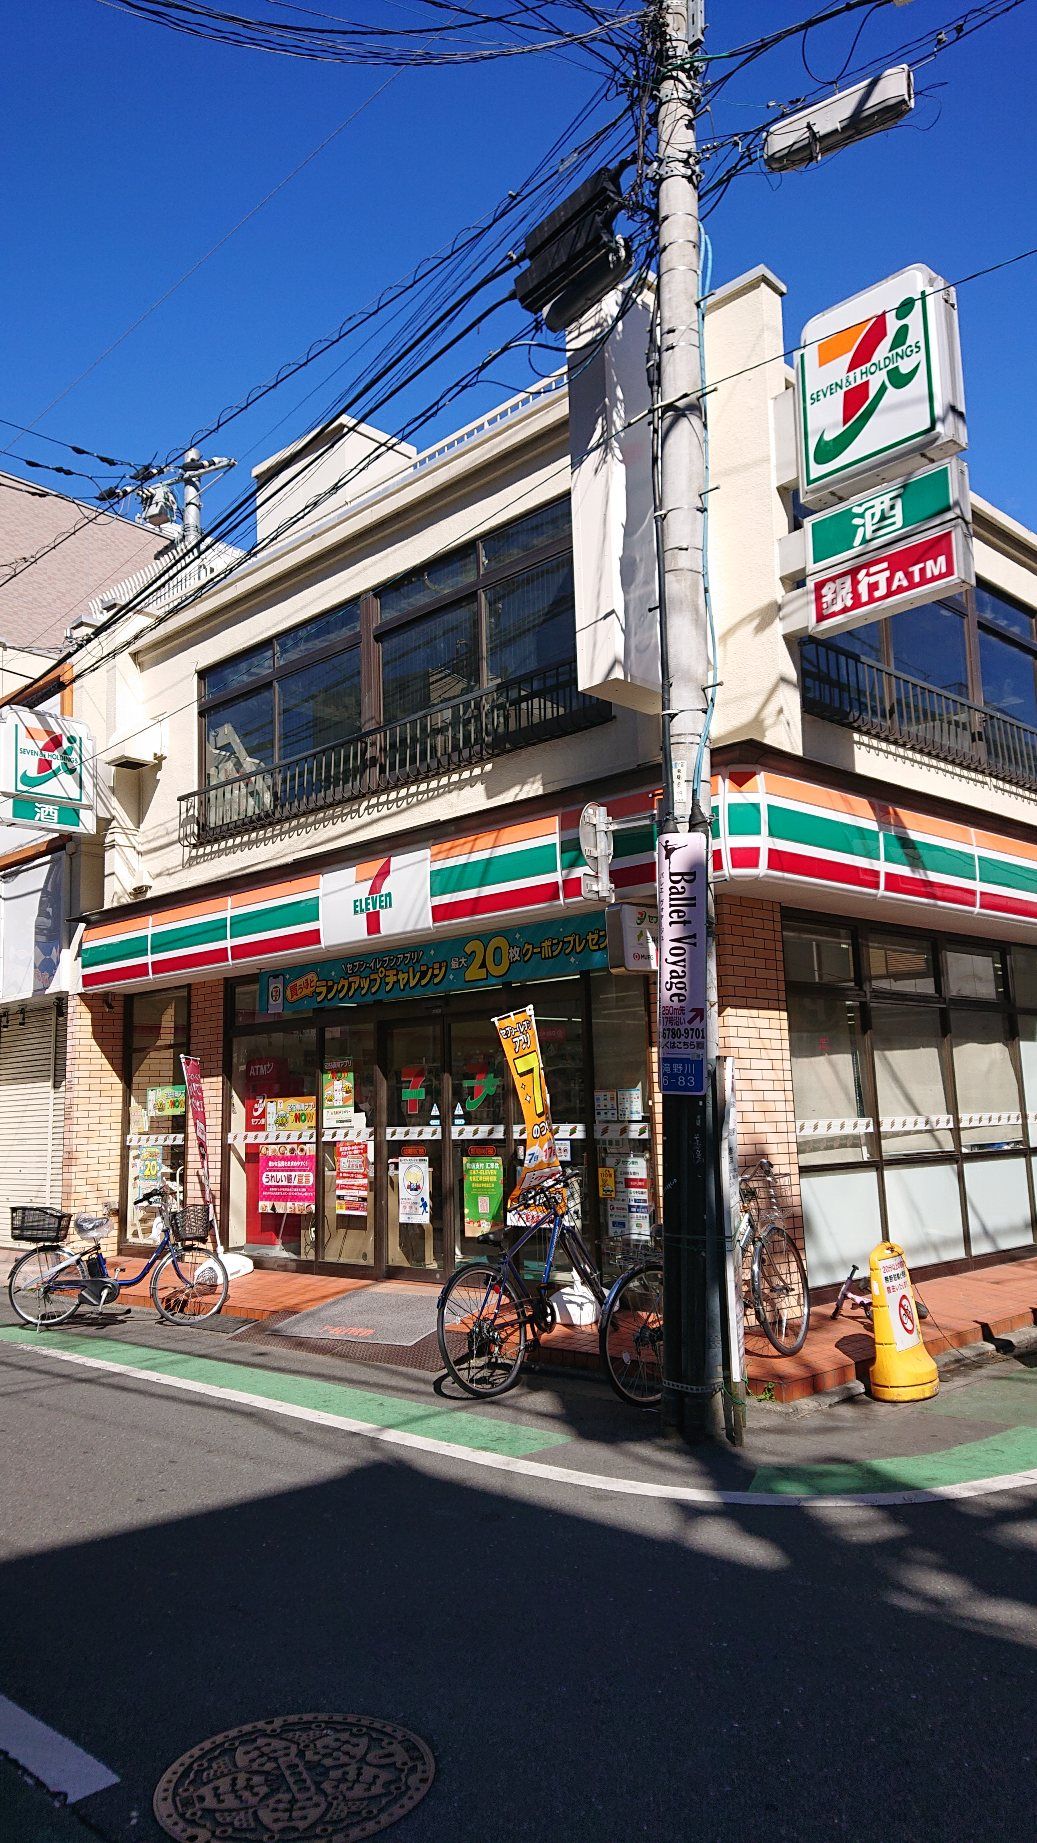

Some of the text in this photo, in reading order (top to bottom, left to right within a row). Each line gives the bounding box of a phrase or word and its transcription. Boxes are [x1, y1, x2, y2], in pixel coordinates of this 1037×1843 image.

[861, 341, 921, 380] HOLDINGS
[852, 487, 905, 547] 酒
[47, 753, 78, 764] HOLDINGS
[34, 803, 60, 823] 酒
[665, 871, 697, 1003] Ballet Voyage
